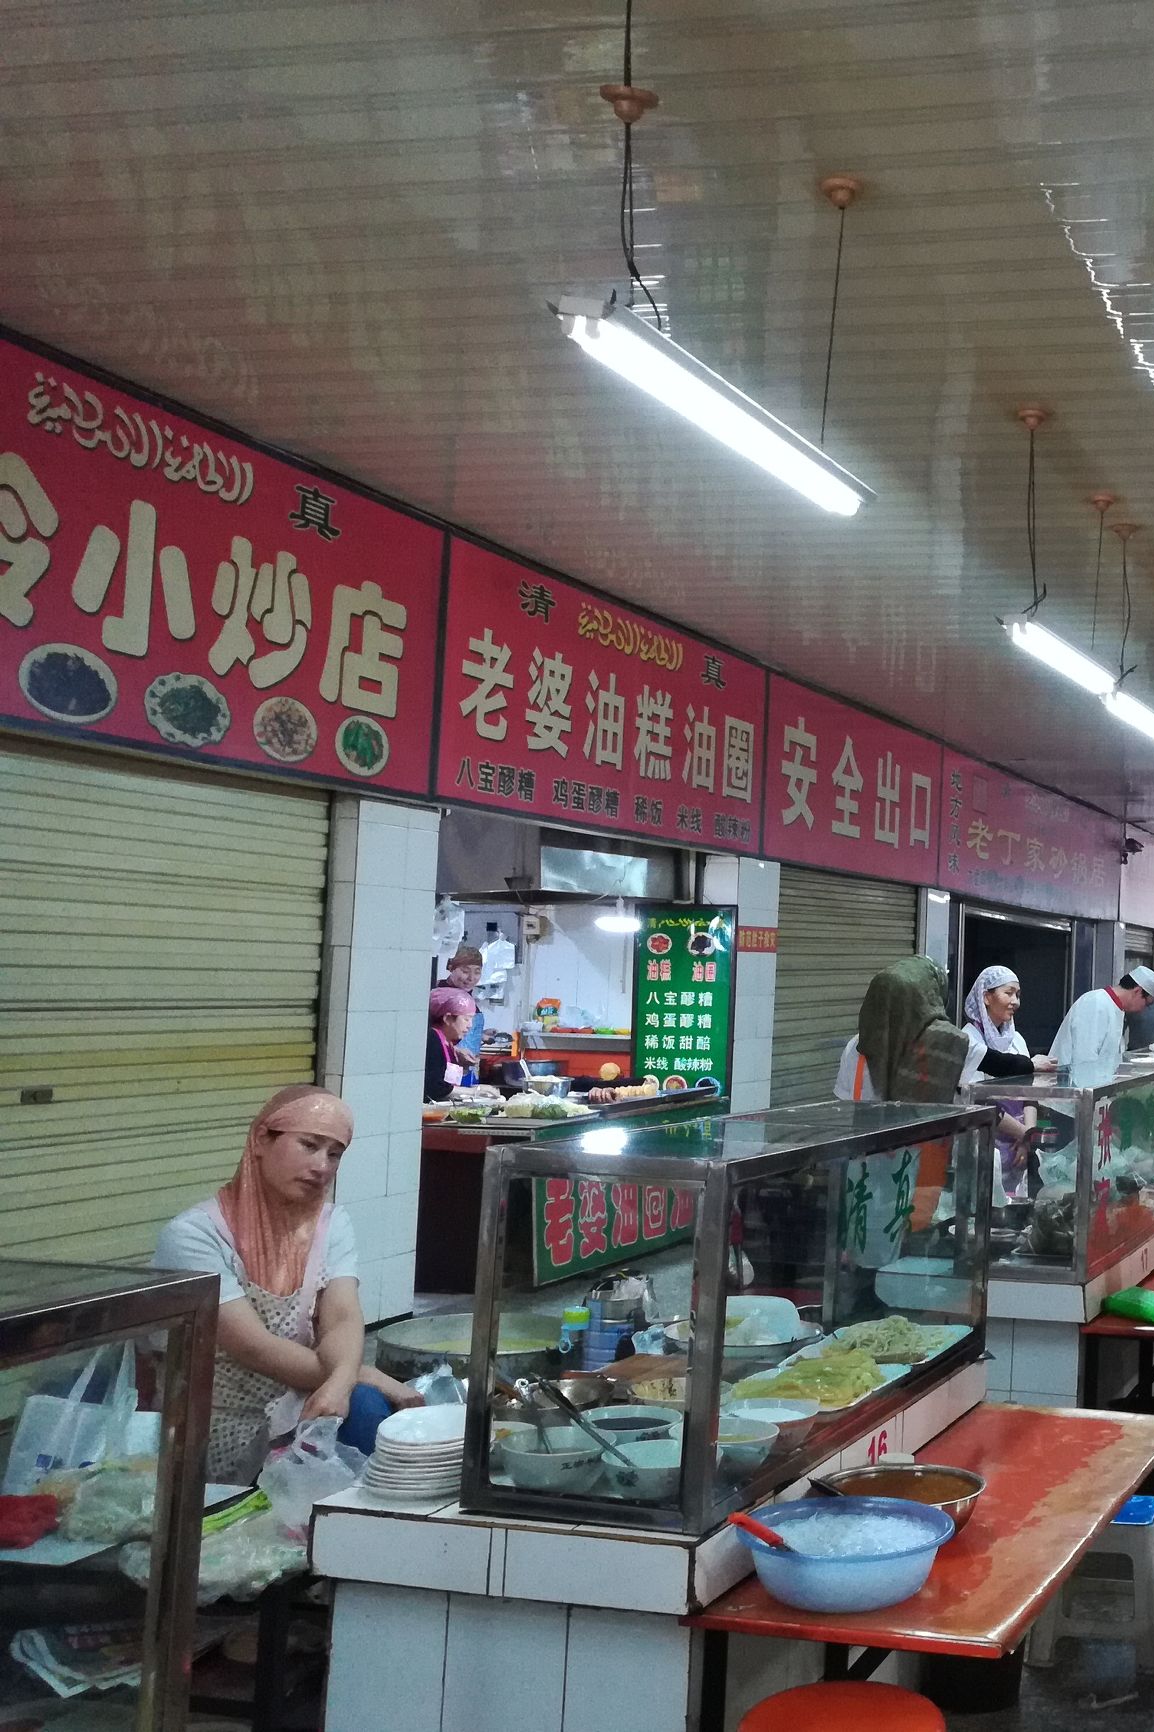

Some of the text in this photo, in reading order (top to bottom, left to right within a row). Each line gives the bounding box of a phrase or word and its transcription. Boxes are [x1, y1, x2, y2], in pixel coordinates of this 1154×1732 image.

[288, 485, 341, 541] 真
[517, 580, 557, 624] 清
[701, 655, 727, 690] 真
[459, 627, 755, 804] 老婆油糕油圈
[455, 755, 536, 803] 八宝醪糟
[552, 777, 621, 820] 鸡蛋醪糟
[633, 795, 664, 828] 稀饭
[675, 804, 704, 835] 米线
[780, 716, 932, 850] 安全出口
[646, 991, 713, 1008] 八宝醪糟
[645, 1012, 713, 1029] 鸡蛋醪糟
[643, 1056, 714, 1072] 米线 酸辣粉
[867, 1429, 888, 1466] 16
